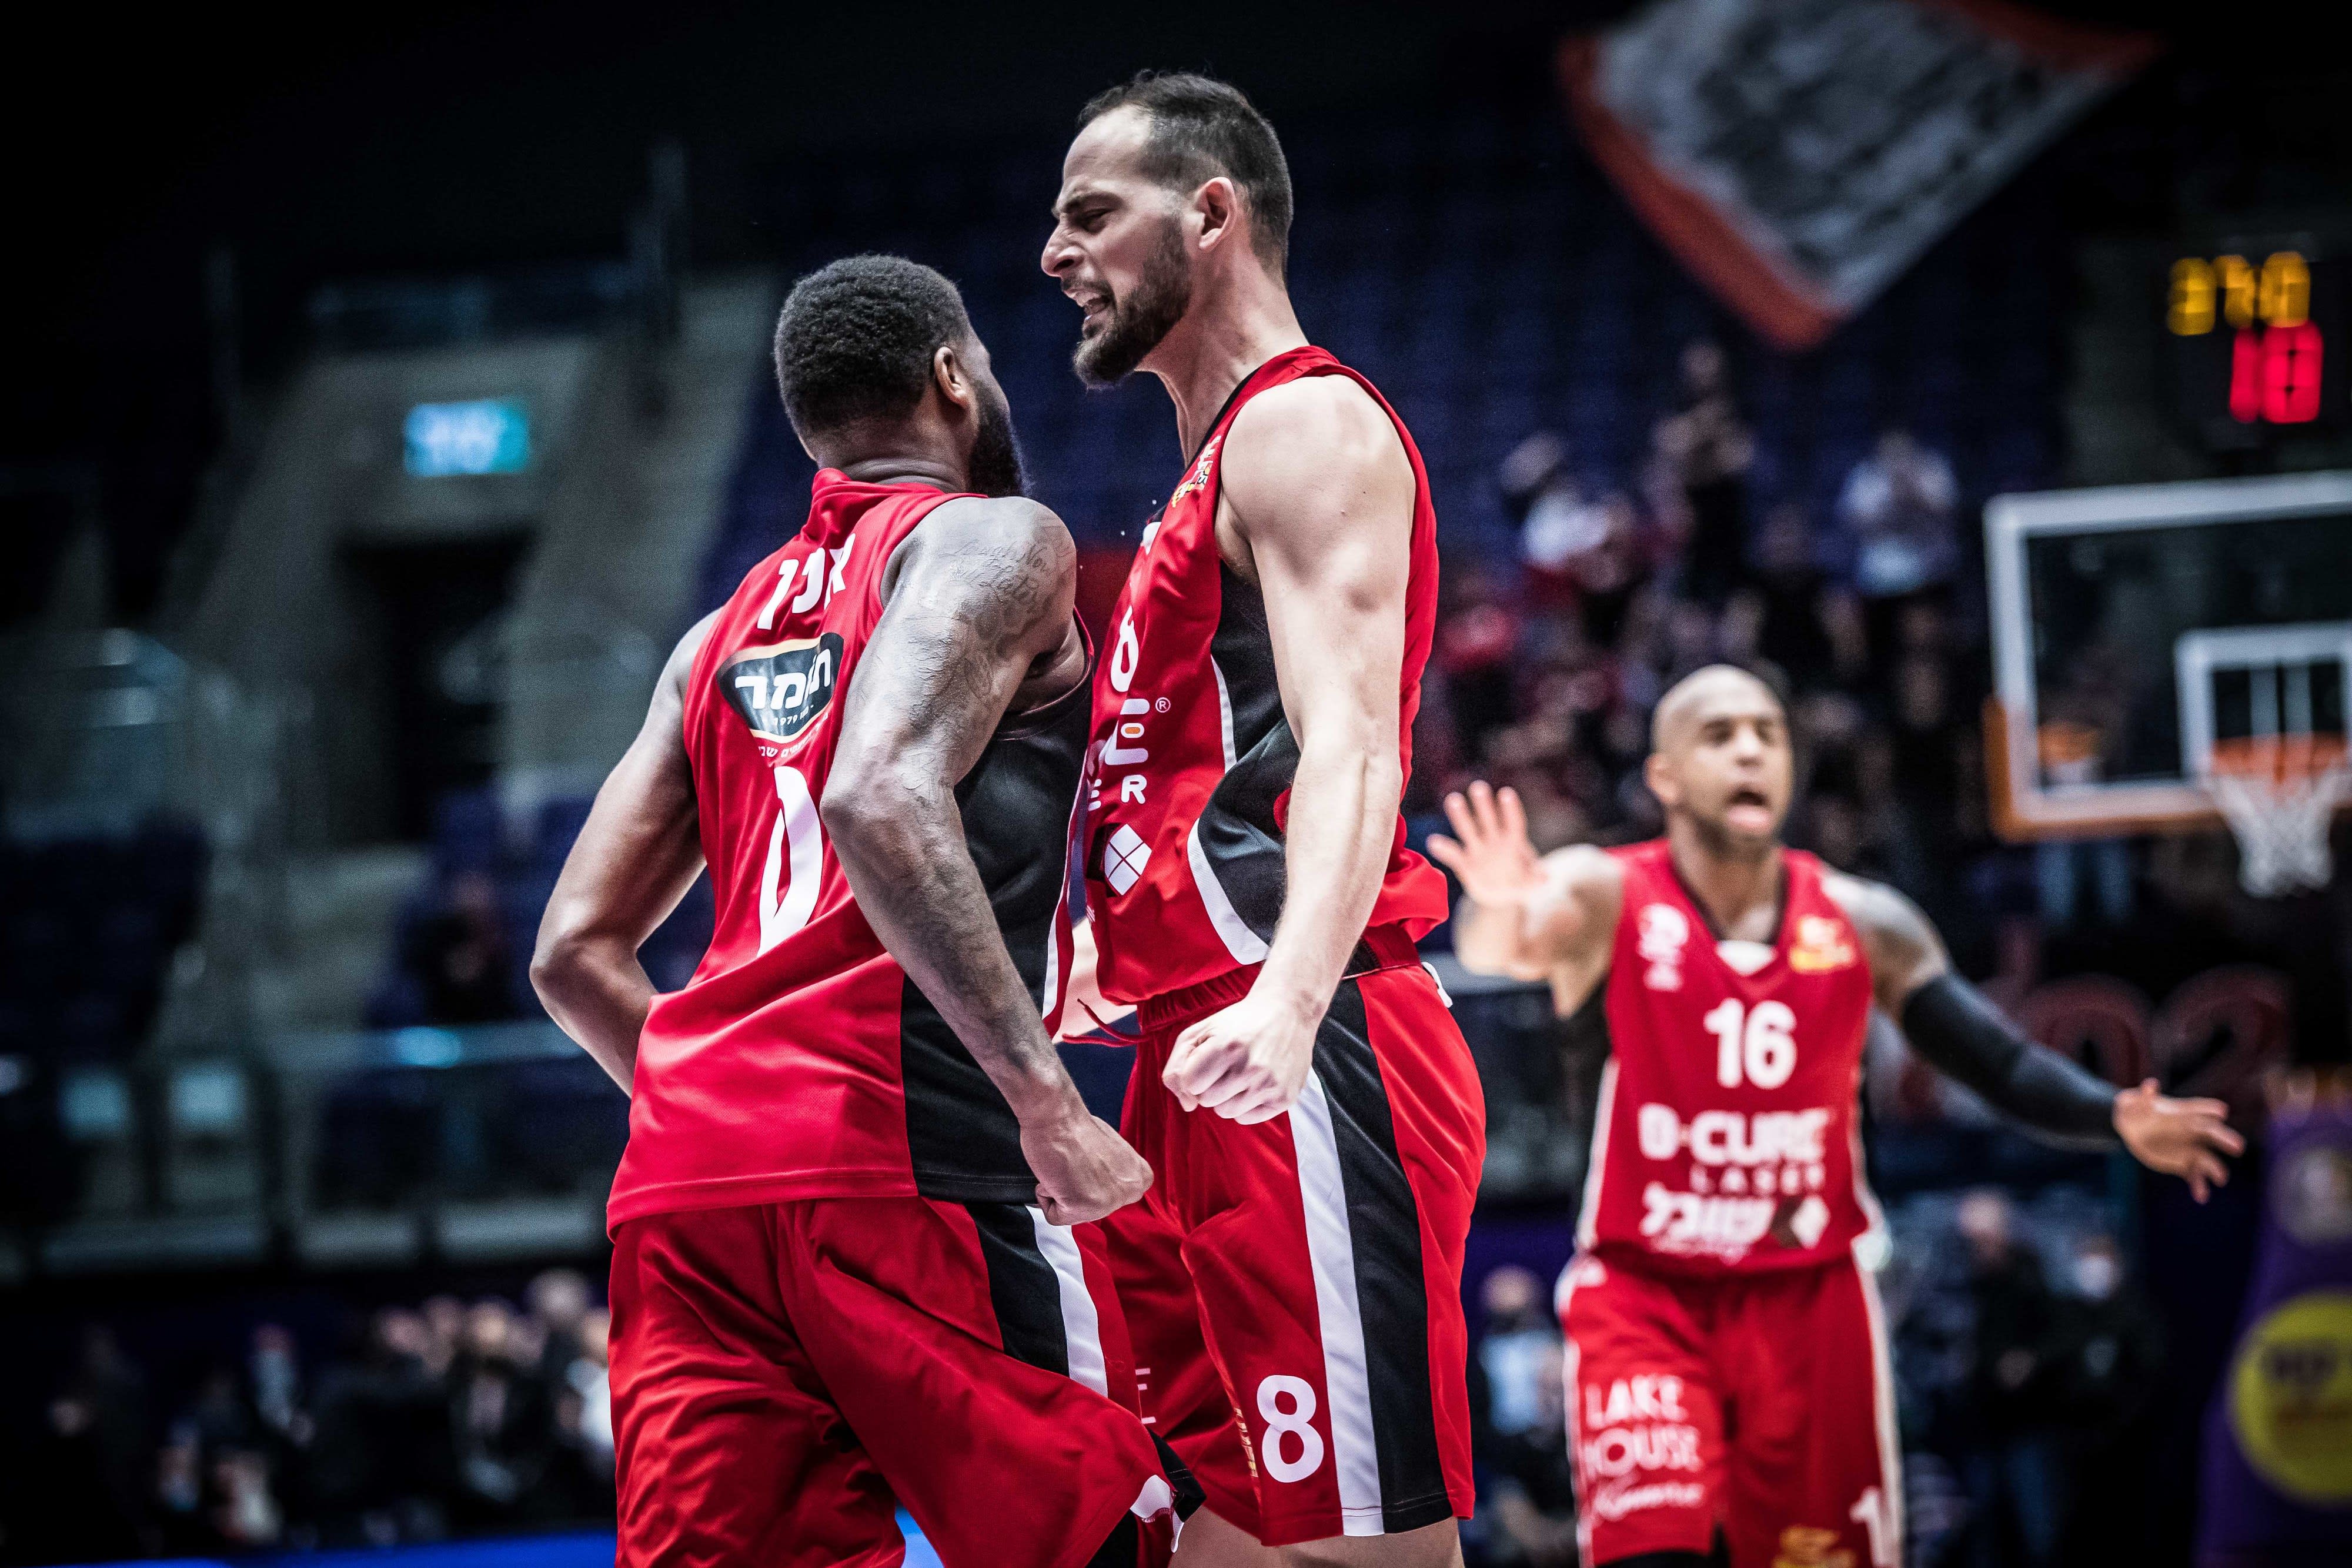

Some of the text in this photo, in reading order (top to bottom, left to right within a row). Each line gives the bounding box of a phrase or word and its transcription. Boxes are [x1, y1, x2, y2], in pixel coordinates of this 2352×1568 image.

[1703, 998, 1798, 1089] 16
[1257, 1375, 1324, 1483] 8
[1585, 1375, 1688, 1430] LAKE
[1584, 1423, 1704, 1480] HOUSE
